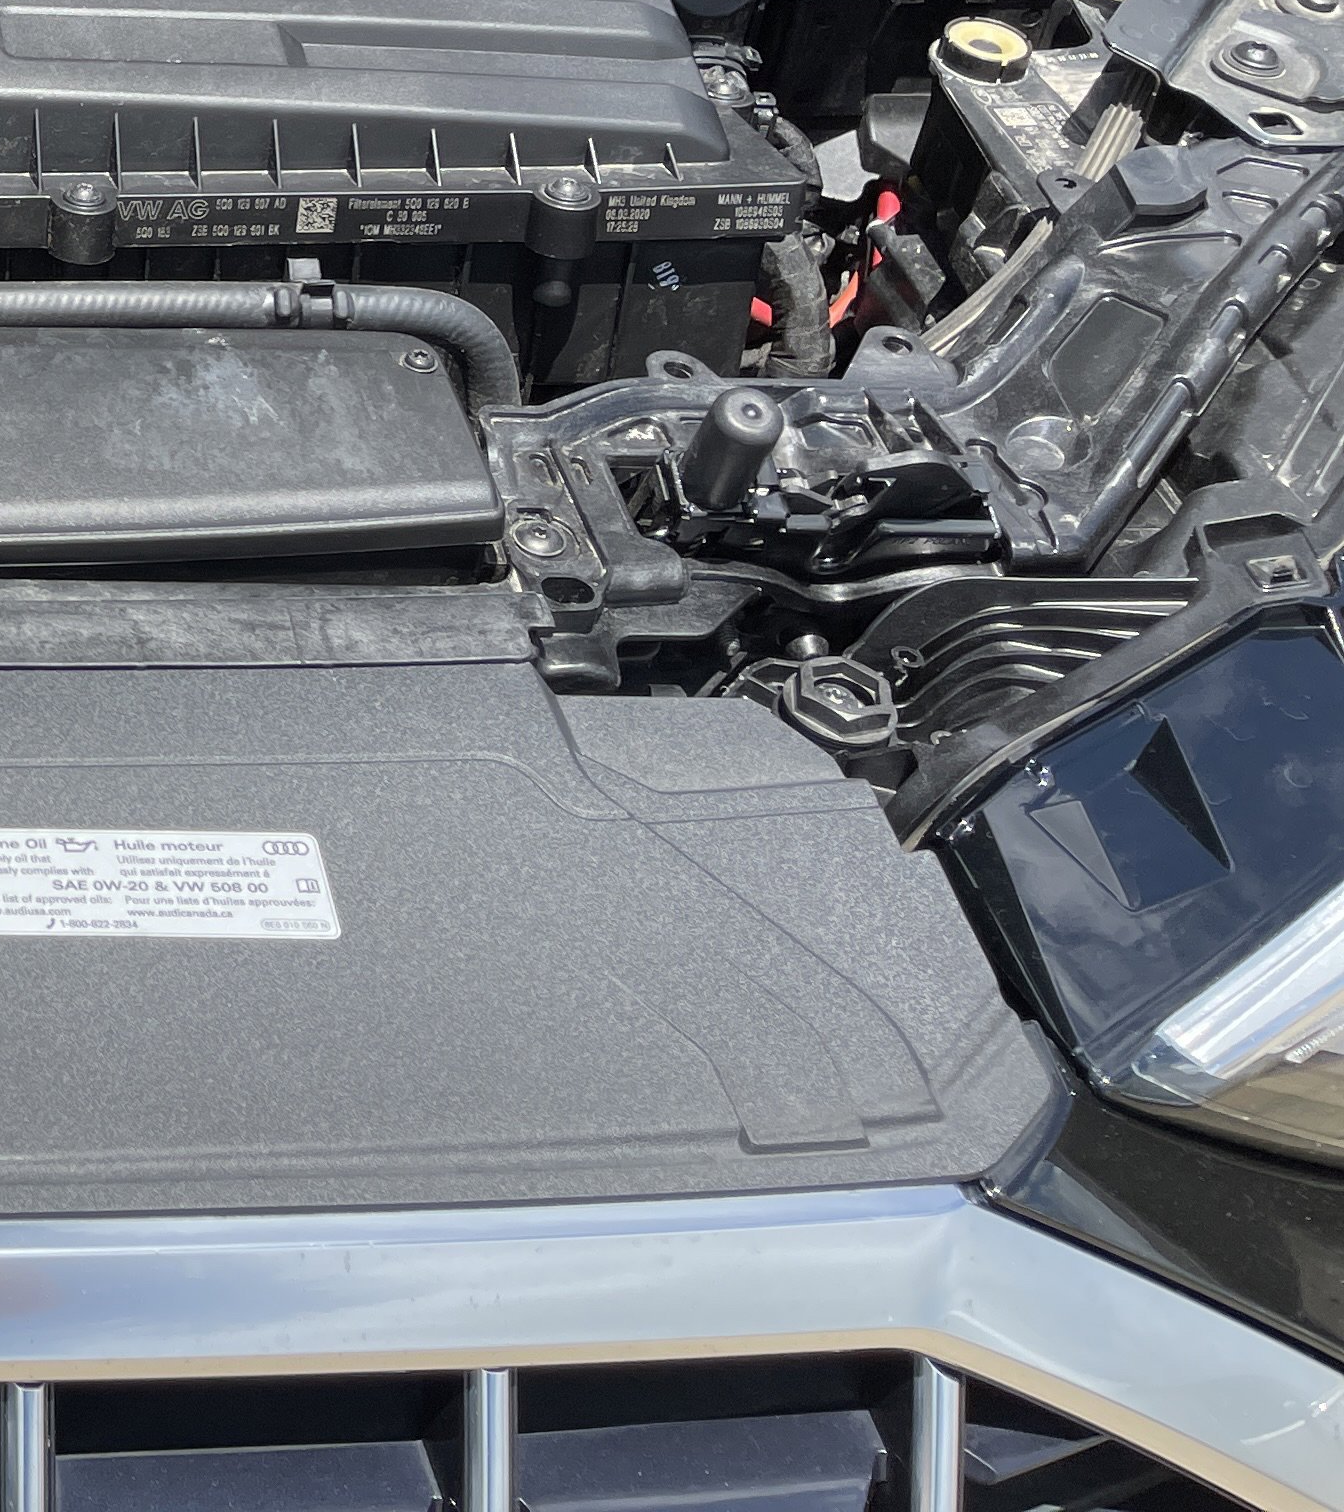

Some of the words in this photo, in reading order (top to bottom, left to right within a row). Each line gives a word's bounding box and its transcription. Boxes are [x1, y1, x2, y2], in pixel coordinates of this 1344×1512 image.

[660, 194, 696, 208] Kingdom
[718, 193, 742, 204] MANN
[756, 192, 791, 204] HUMMEL
[117, 199, 163, 221] VW
[166, 199, 210, 220] AG
[25, 838, 48, 849] Oil
[113, 839, 156, 852] Huile
[161, 841, 224, 852] moteur
[14, 853, 28, 863] oil
[30, 854, 52, 863] that
[158, 856, 224, 867] uniquement
[226, 856, 240, 866] de
[20, 867, 69, 877] complies
[71, 867, 95, 876] with
[119, 869, 138, 878] qui
[51, 879, 88, 891] SAE
[93, 880, 149, 892] 0W-20
[154, 881, 169, 892] &
[172, 881, 205, 892] VW
[211, 882, 243, 893] 508
[247, 882, 269, 893] 00
[2, 894, 20, 904] list
[21, 894, 33, 904] of
[35, 894, 87, 906] approved
[124, 895, 150, 905] Pour
[153, 896, 174, 905] une
[177, 896, 201, 906] liste
[202, 896, 246, 907] d'huiles
